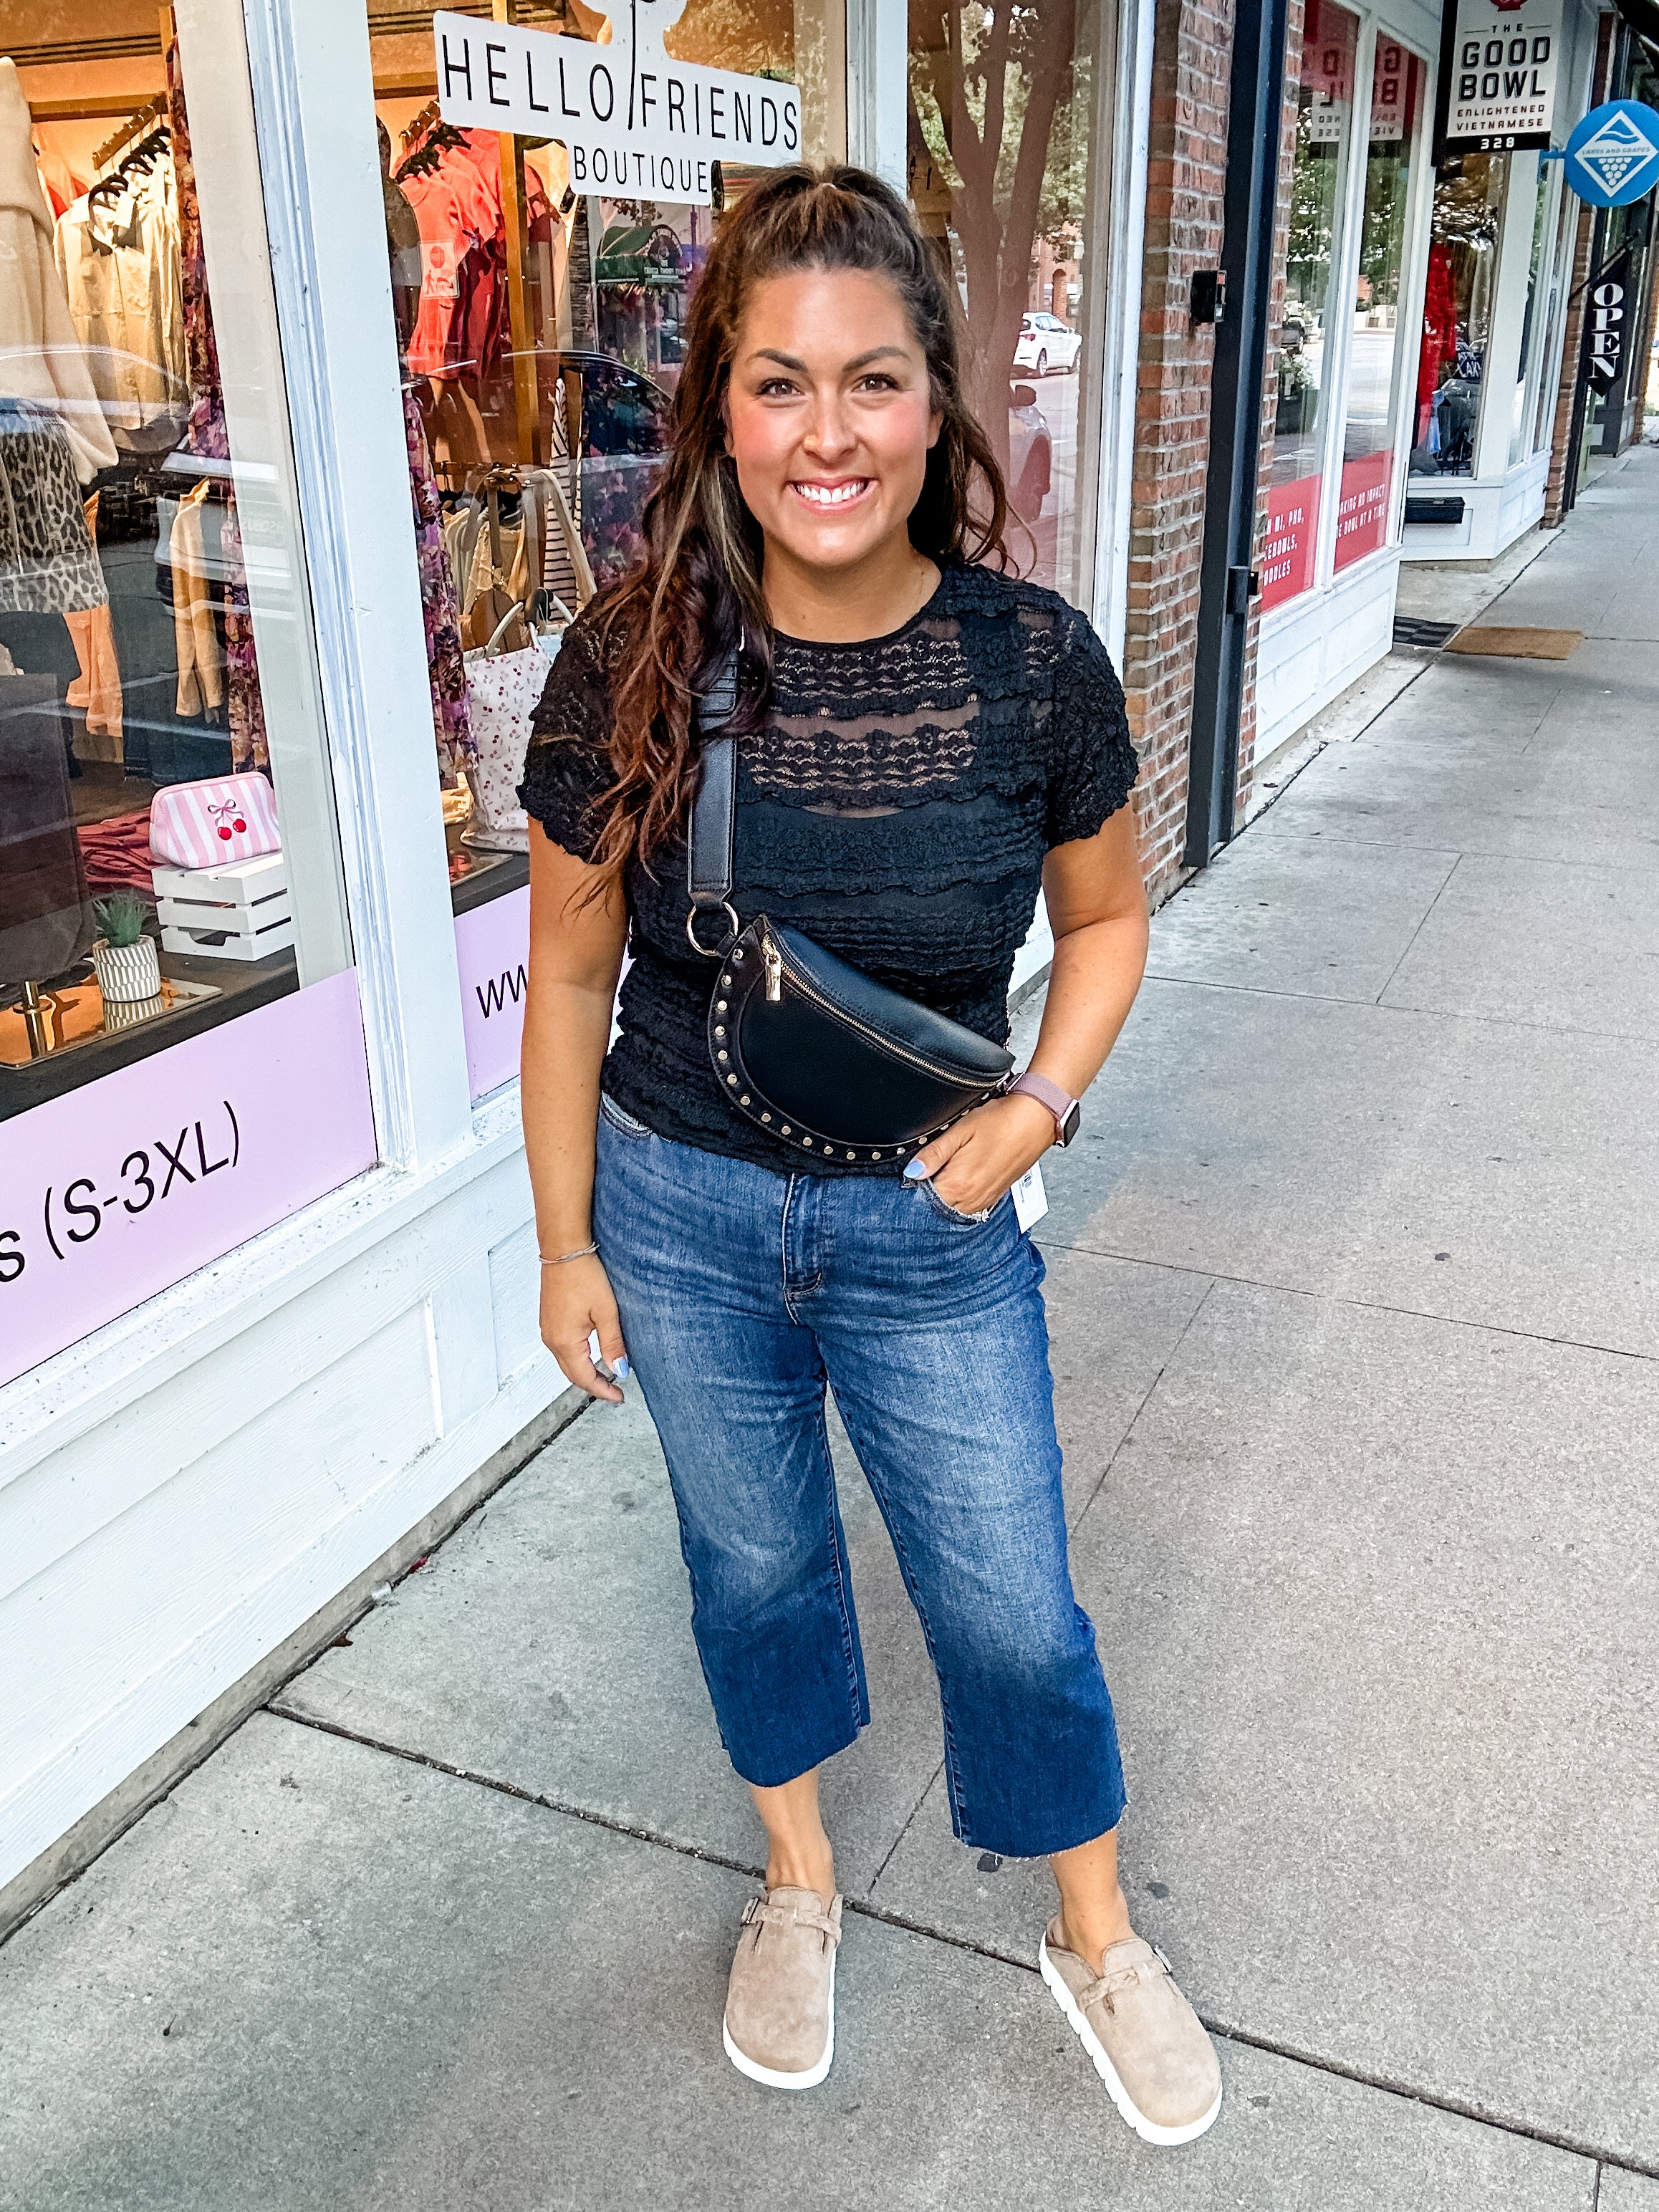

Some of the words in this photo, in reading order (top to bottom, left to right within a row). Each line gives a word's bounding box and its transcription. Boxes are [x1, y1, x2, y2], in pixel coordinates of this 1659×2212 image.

[1491, 24, 1523, 34] THE
[1461, 37, 1551, 69] GOOD
[441, 34, 614, 122] HELLO
[640, 73, 798, 150] FRIENDS
[1458, 69, 1547, 102] BOWL
[1456, 118, 1544, 131] VIETNAMESE
[1457, 105, 1545, 117] ENLIGHTENED
[1480, 137, 1515, 150] 328
[573, 145, 708, 193] BOUTIQUE
[1589, 283, 1624, 378] OPEN
[1340, 496, 1357, 516] AKING
[1344, 515, 1358, 535] BOWL
[1360, 511, 1367, 527] AT
[1263, 559, 1291, 587] OODLES
[44, 1100, 239, 1260] (S-3XL)
